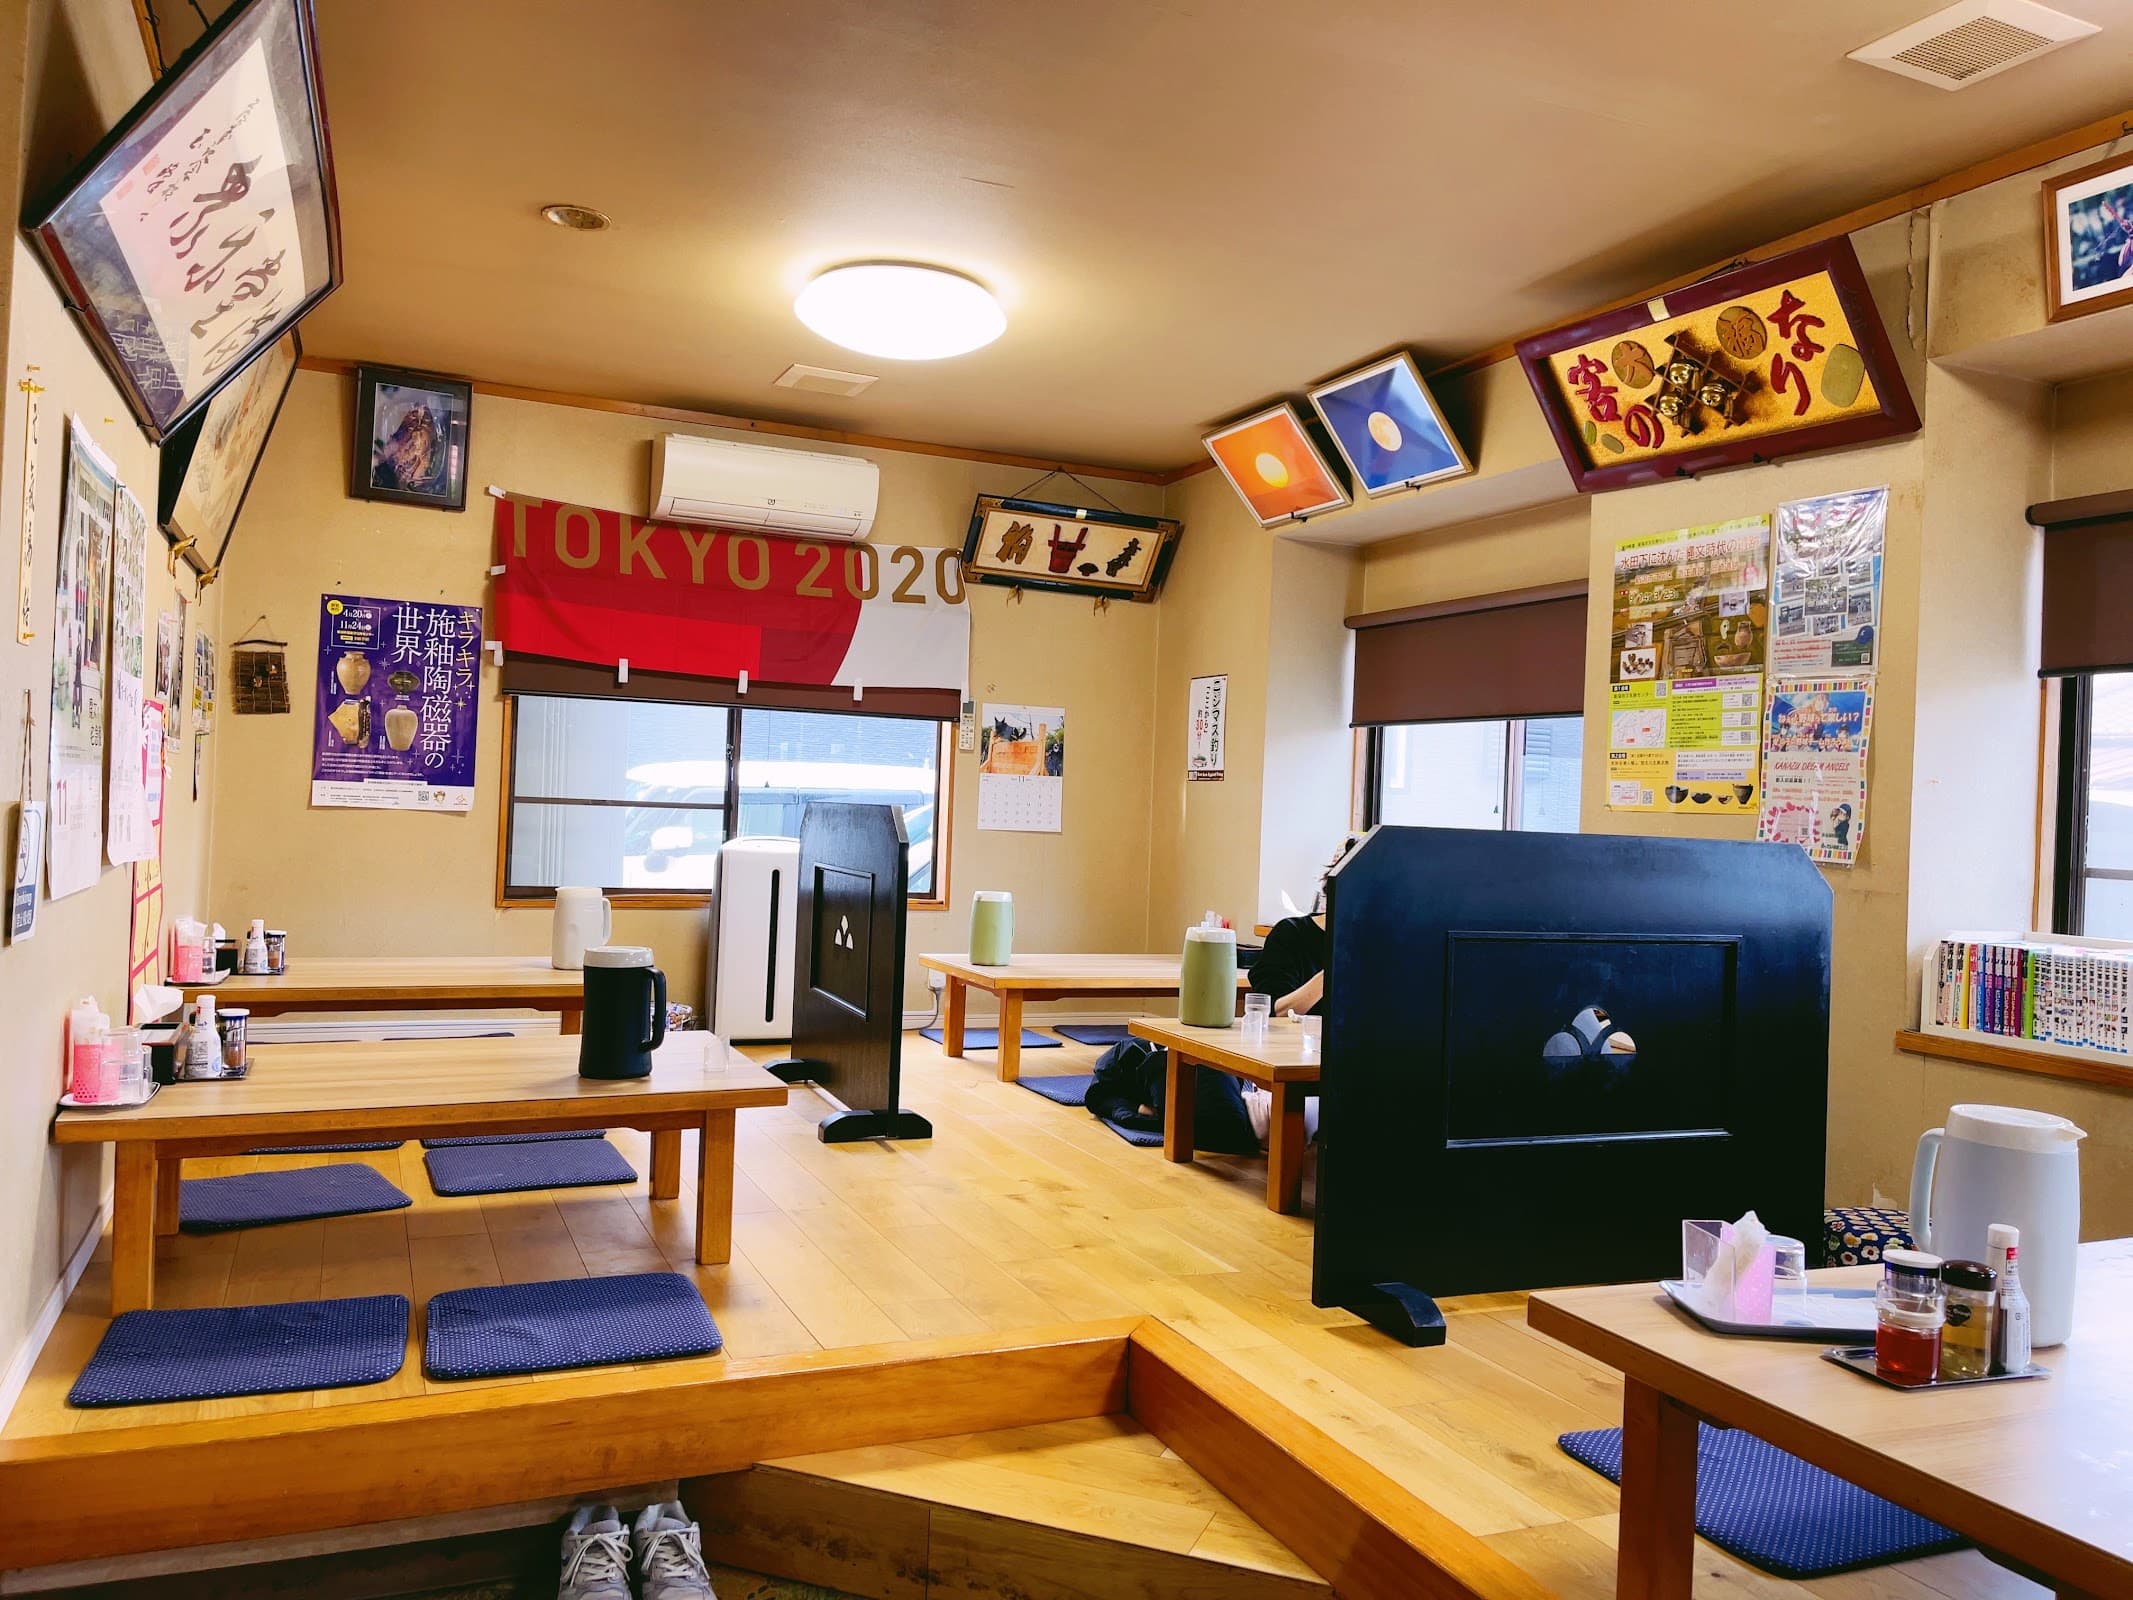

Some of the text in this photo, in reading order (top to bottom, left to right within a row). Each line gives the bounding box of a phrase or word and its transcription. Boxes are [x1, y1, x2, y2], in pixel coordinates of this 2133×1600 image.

[502, 493, 771, 591] TOKYO
[794, 541, 968, 604] 2020
[391, 605, 425, 665] 世界
[455, 611, 477, 687] キラキラ
[420, 608, 457, 769] 施釉陶磁器の
[1210, 680, 1221, 768] ニジマス釣り
